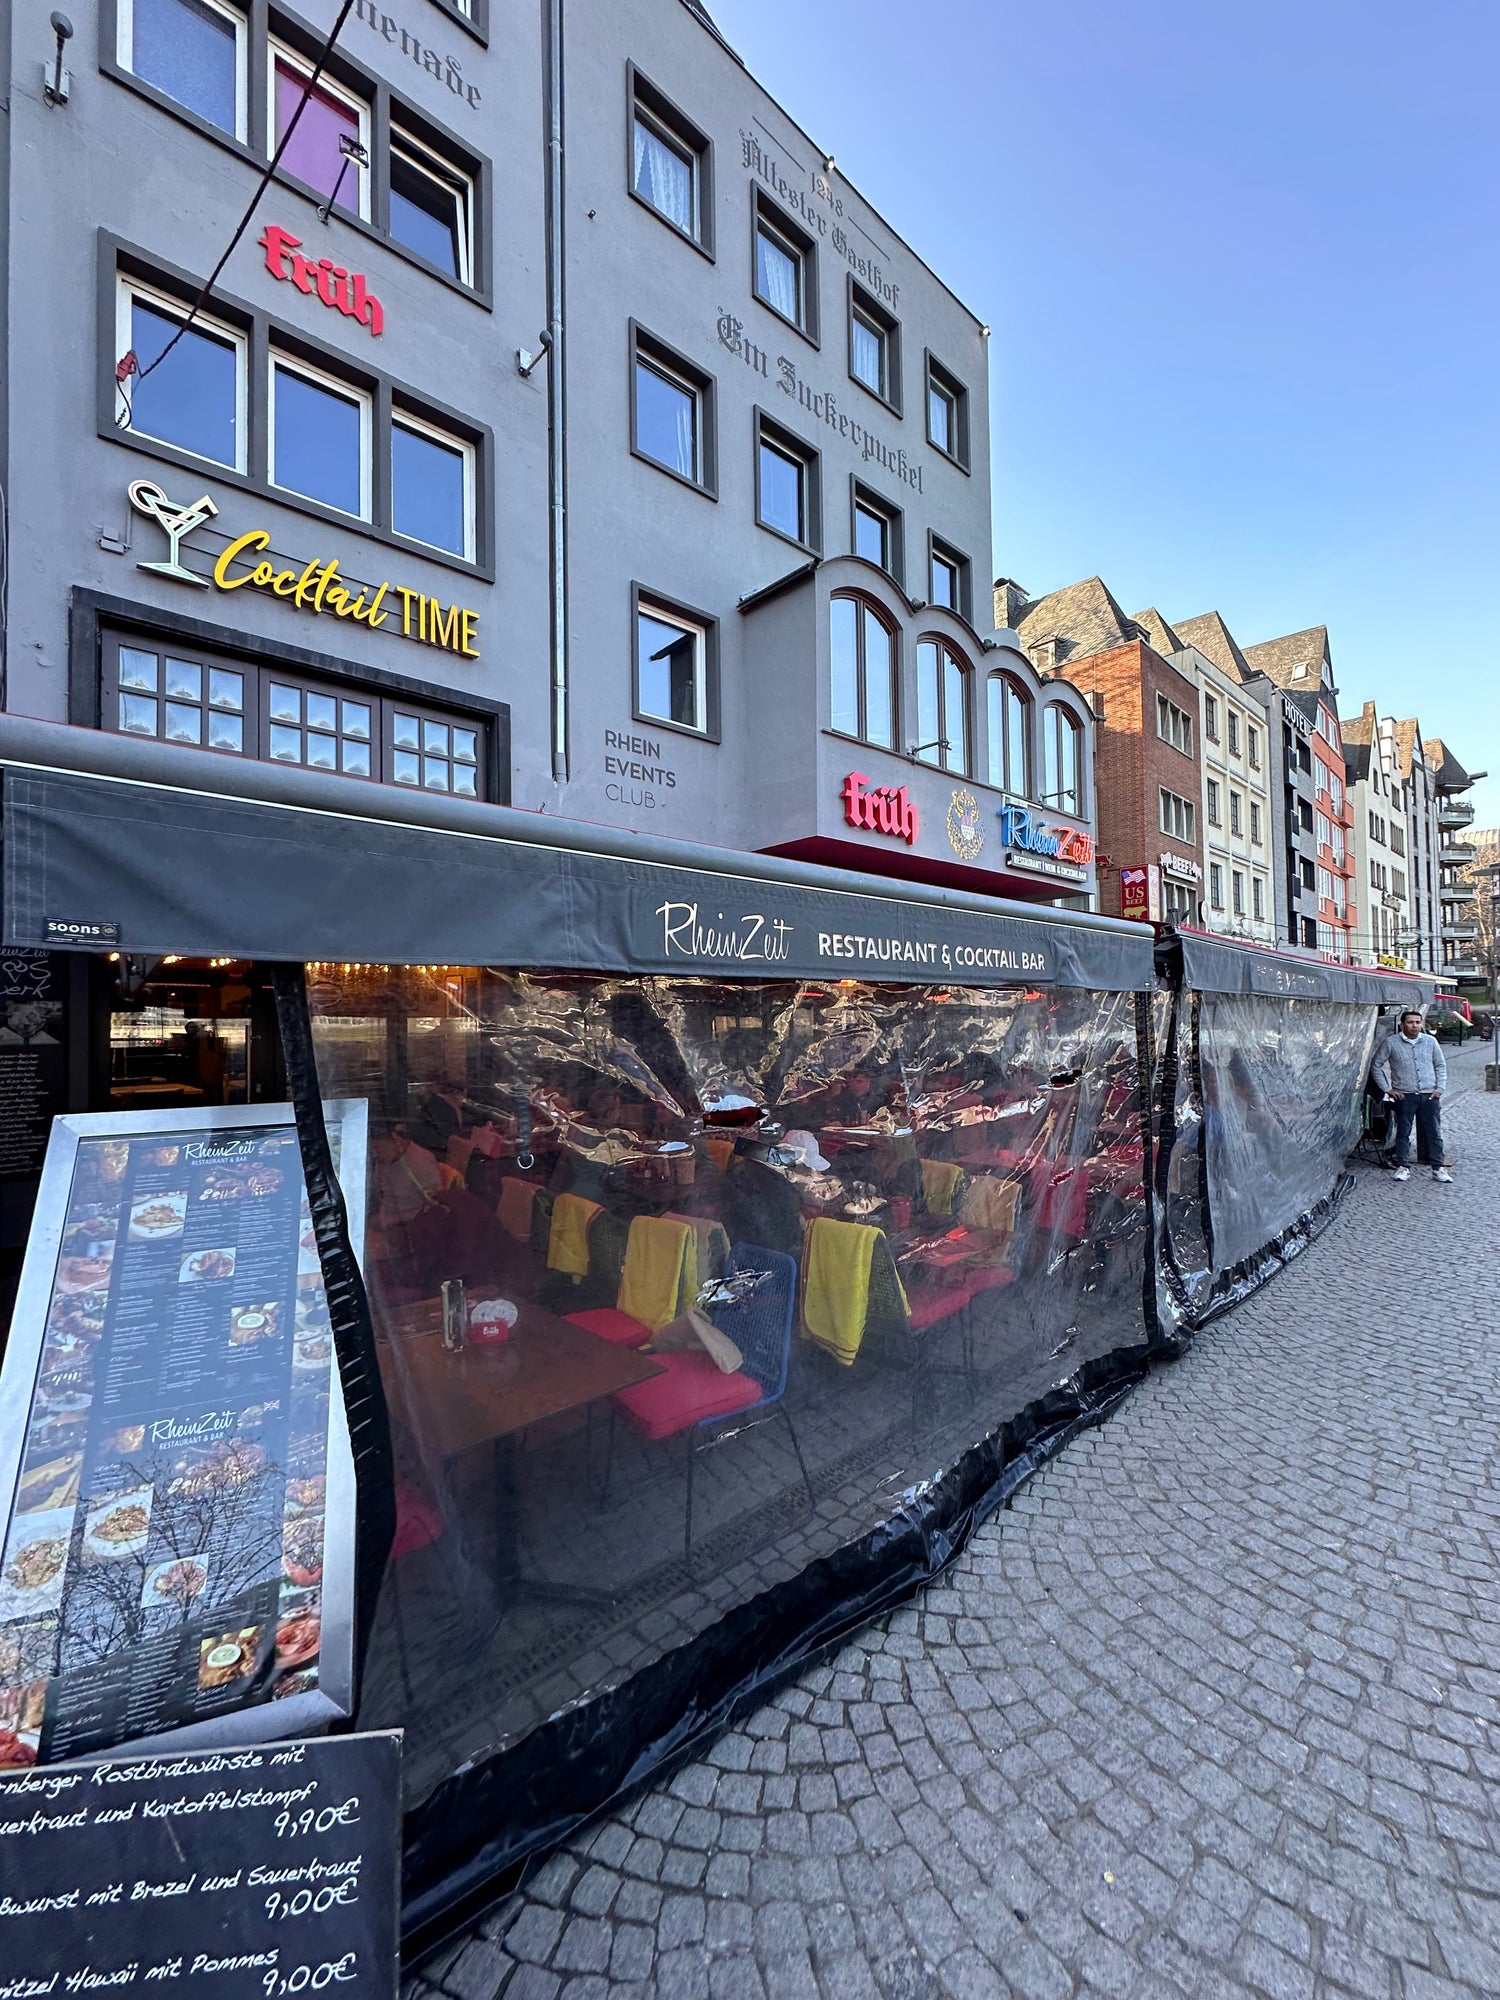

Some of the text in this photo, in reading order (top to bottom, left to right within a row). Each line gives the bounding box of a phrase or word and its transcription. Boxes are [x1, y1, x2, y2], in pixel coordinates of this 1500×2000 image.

[810, 173, 844, 217] 1248
[831, 223, 900, 310] Gasthof
[776, 355, 924, 495] Zuckerpuckel
[213, 530, 480, 659] Cocktail TIME
[1284, 698, 1308, 737] HOTEL
[604, 729, 661, 760] RHEIN
[604, 755, 676, 788] EVENTS
[605, 783, 656, 809] CLUB
[1124, 886, 1145, 899] US
[1125, 898, 1143, 906] BEEF
[48, 922, 101, 935] soons
[655, 900, 795, 960] RheinZeit
[818, 932, 1046, 970] RESTAURANT & COCKTAIL BAR
[181, 1140, 259, 1160] RheinZeit
[191, 1157, 228, 1166] RESTAURANT
[149, 1410, 237, 1443] RheinZeit
[159, 1436, 201, 1450] RESTAURANT
[210, 1431, 224, 1440] BAR
[91, 1750, 263, 1786] Rostbratwürste
[270, 1745, 306, 1766] mit
[94, 1802, 137, 1824] und
[142, 1781, 318, 1818] Kartoffelstampf
[273, 1797, 361, 1838] 9,90€
[85, 1883, 123, 1906] mit
[130, 1873, 197, 1900] Brezel
[200, 1868, 242, 1892] und
[247, 1855, 362, 1886] Sauerkraut
[264, 1877, 359, 1920] 9,00€
[65, 1962, 139, 1993] Hawaii
[144, 1957, 183, 1980] mit
[190, 1948, 280, 1975] Pommes
[262, 1951, 357, 1997] 9,00€
